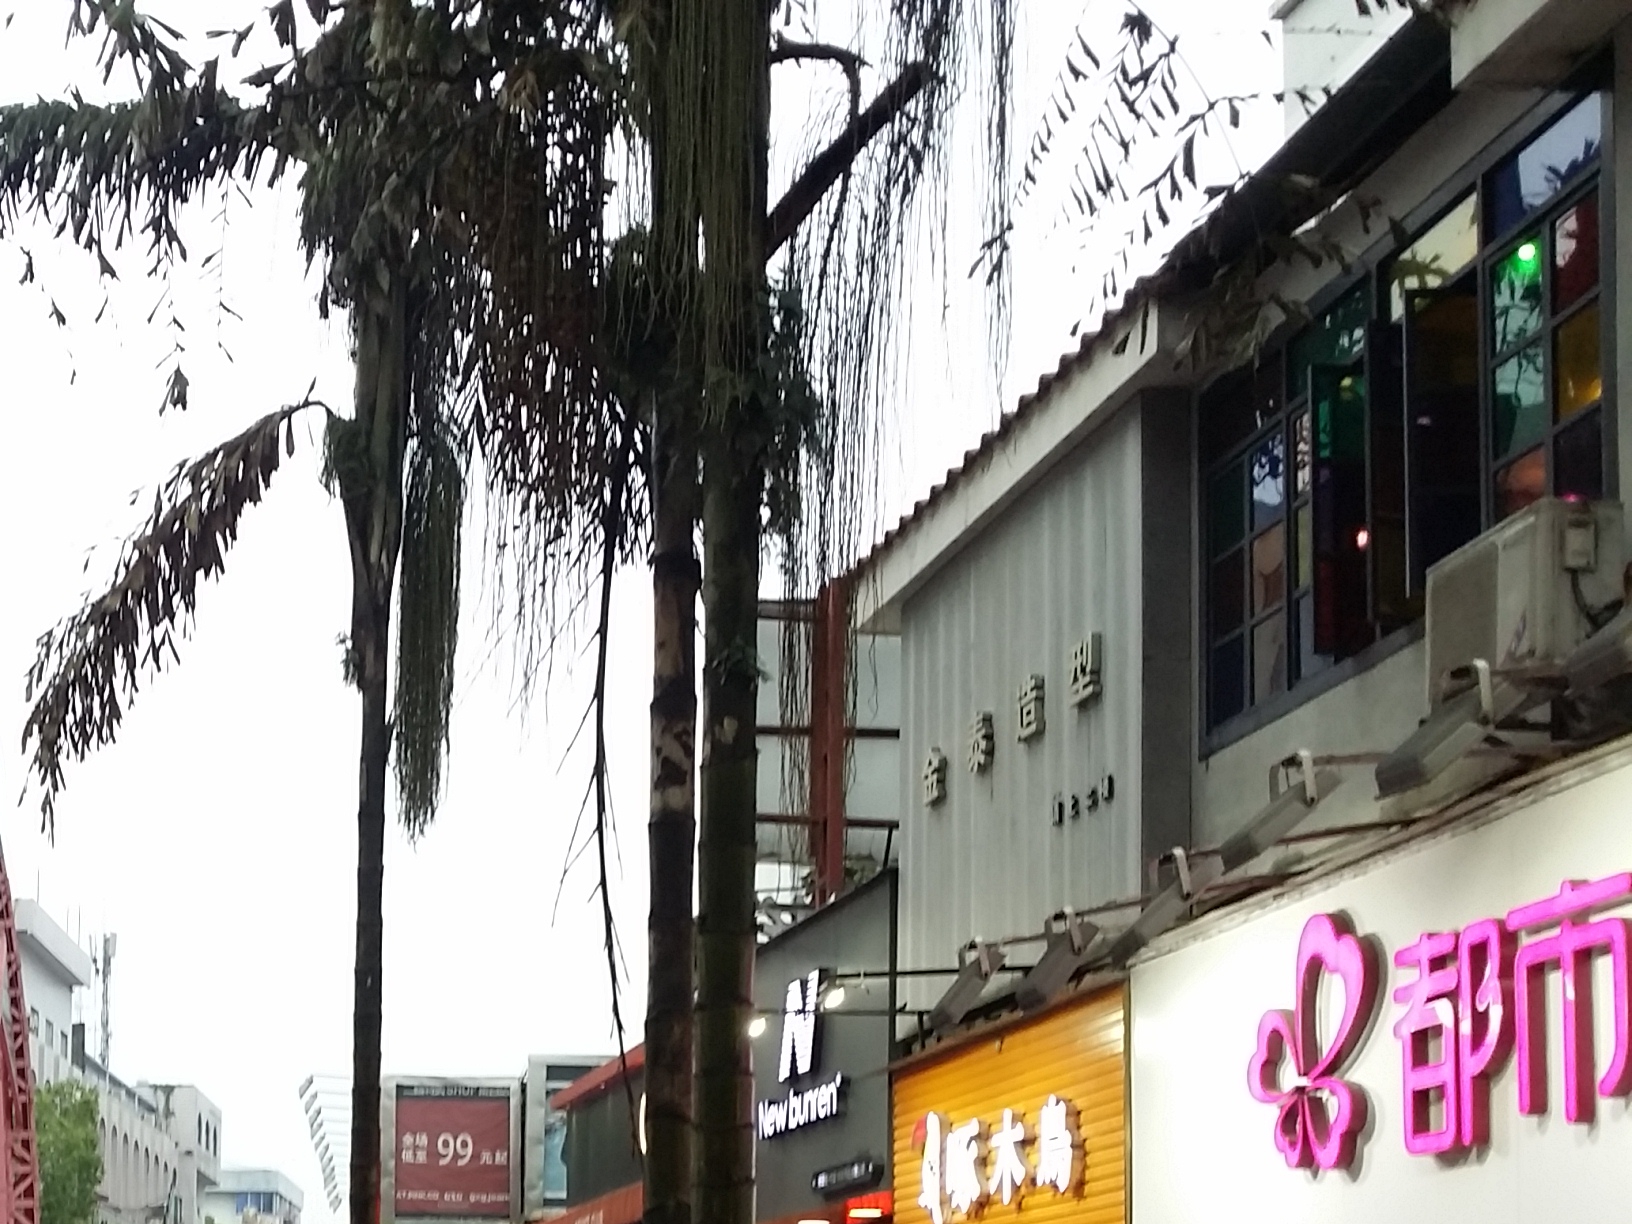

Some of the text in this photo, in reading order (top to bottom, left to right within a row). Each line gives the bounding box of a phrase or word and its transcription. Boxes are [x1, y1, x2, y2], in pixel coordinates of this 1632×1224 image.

[922, 631, 1102, 807] 金泰造型
[1394, 871, 1632, 1157] 都市
[437, 1131, 473, 1167] 99
